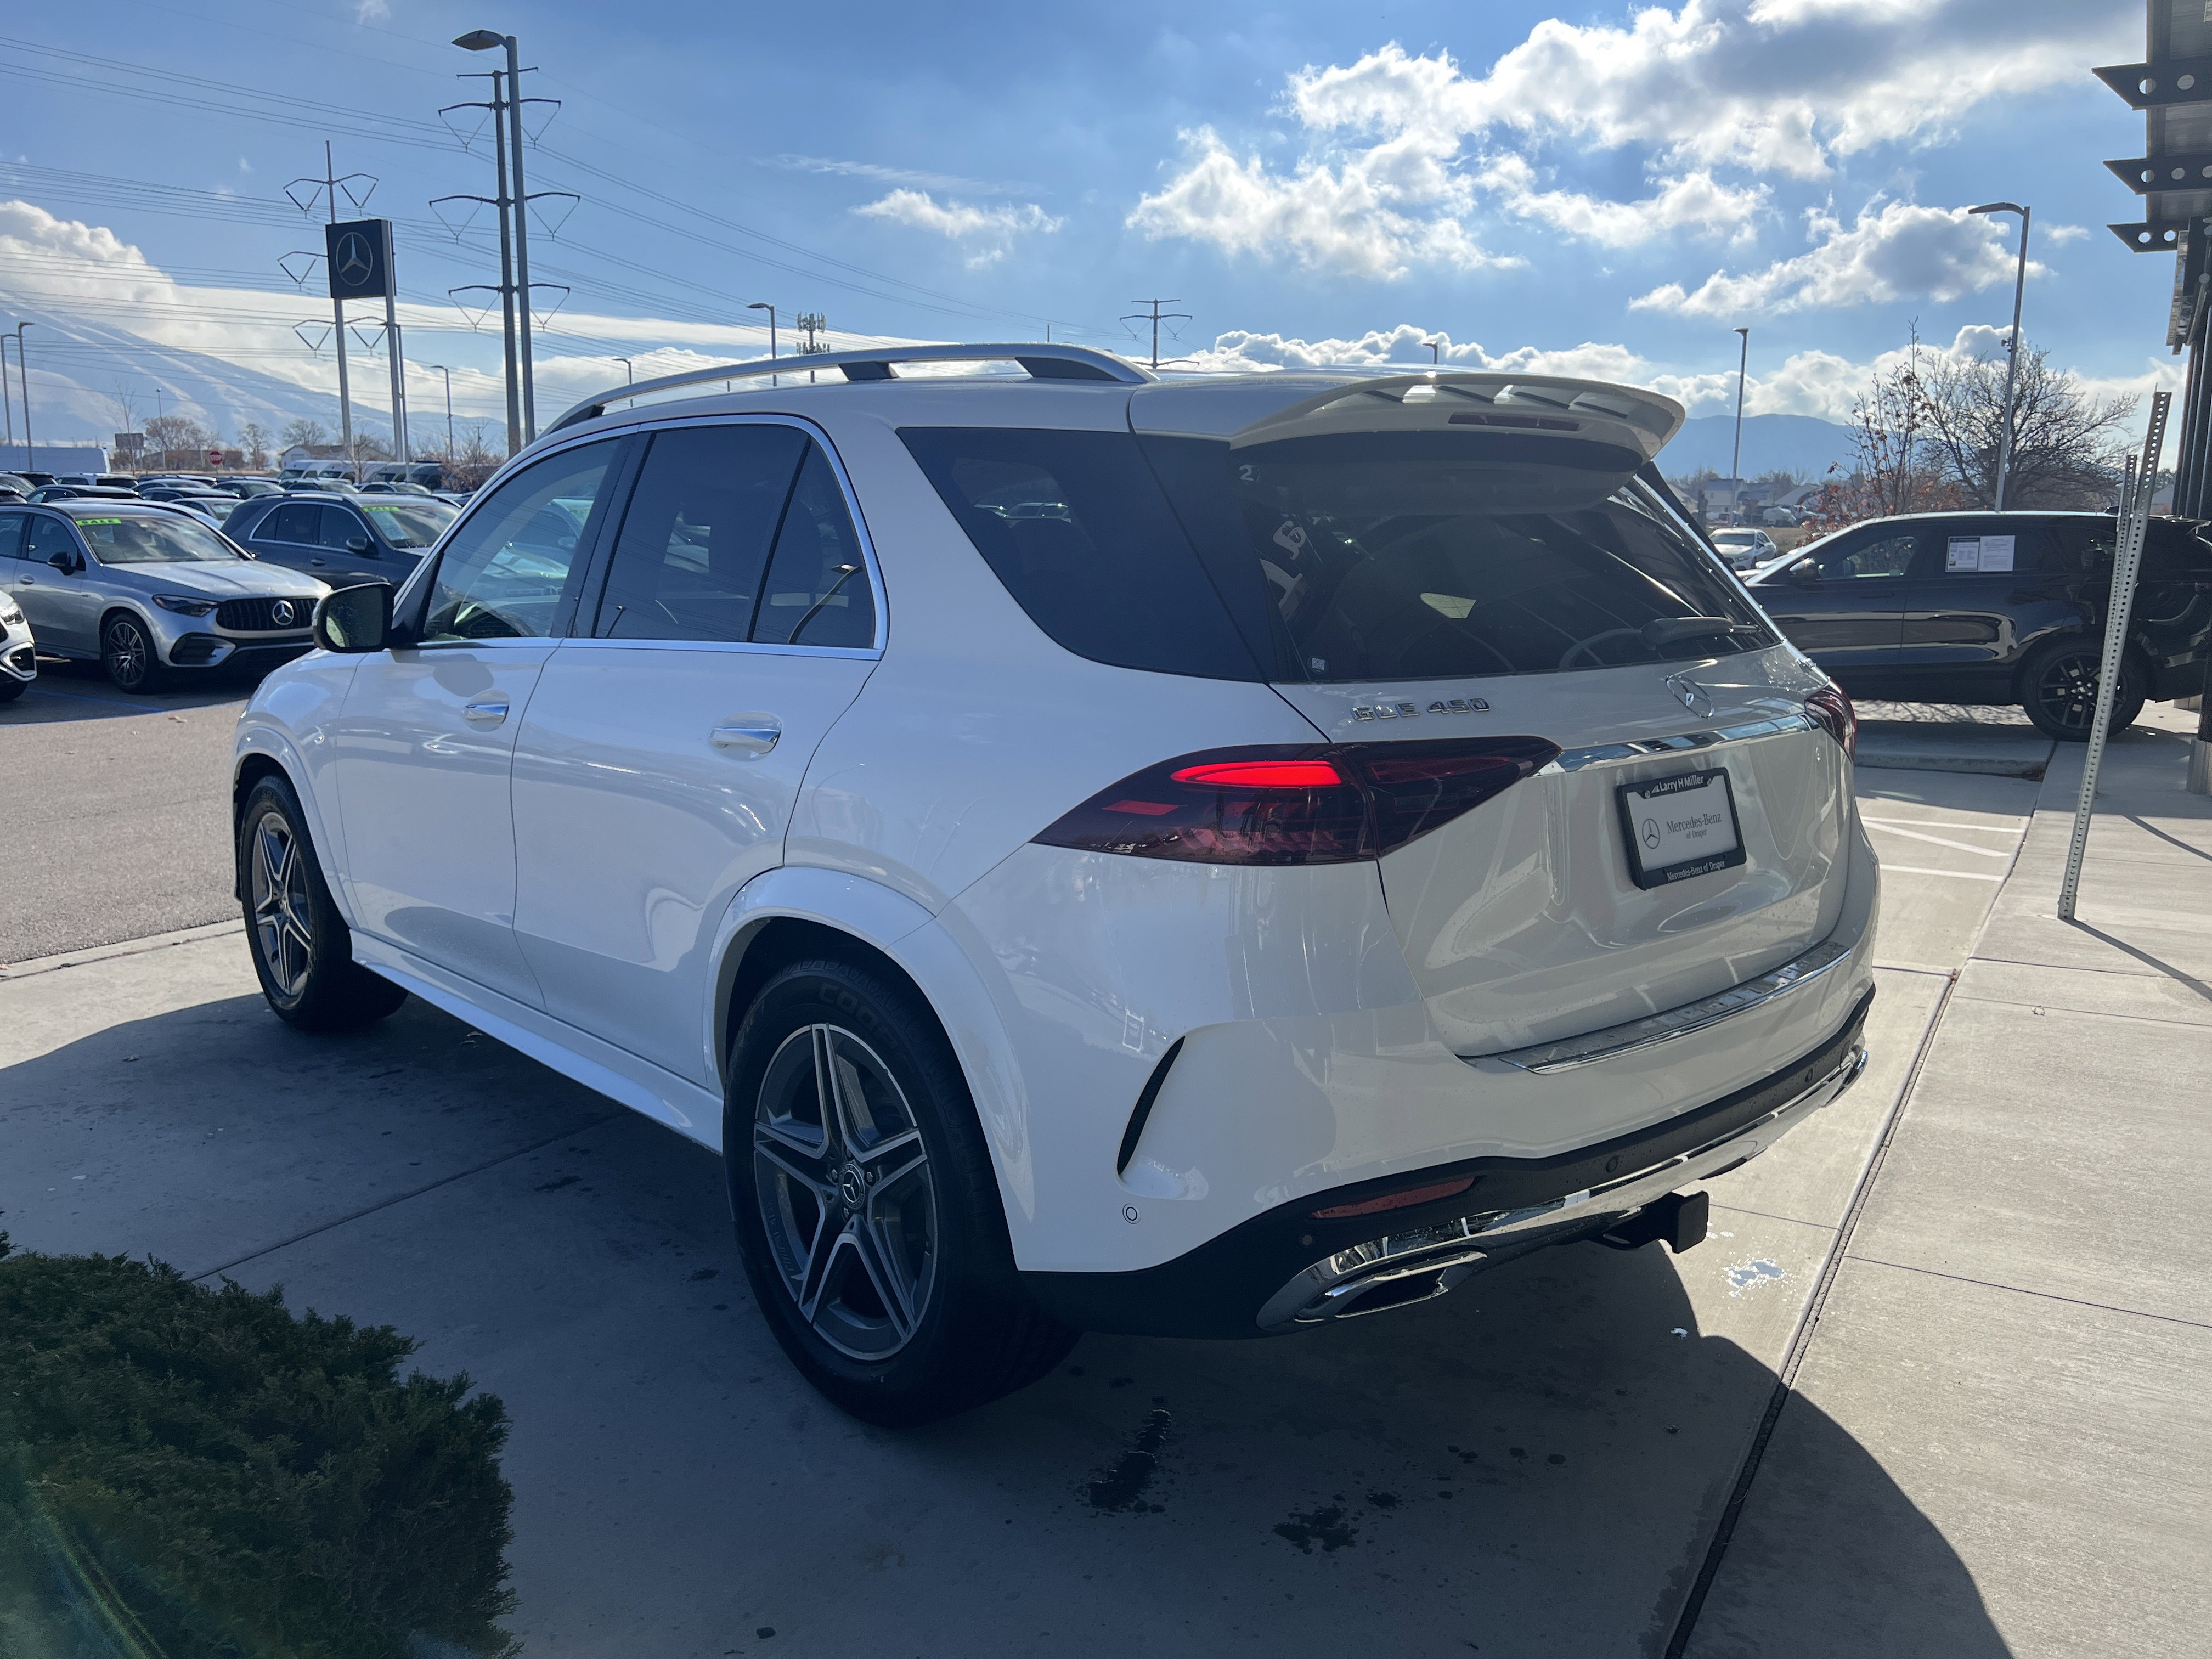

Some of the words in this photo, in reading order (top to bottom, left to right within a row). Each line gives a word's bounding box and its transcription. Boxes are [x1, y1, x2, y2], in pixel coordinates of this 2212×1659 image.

[1350, 703, 1420, 721] GLE
[1426, 698, 1491, 714] 450
[1659, 781, 1678, 792] Larry
[1677, 778, 1684, 788] H
[1684, 774, 1703, 787] Miller
[1666, 813, 1722, 834] Mercedes-Benz
[1686, 831, 1691, 839] of
[1667, 866, 1703, 882] Mercedes-Benz
[1703, 862, 1709, 872] of
